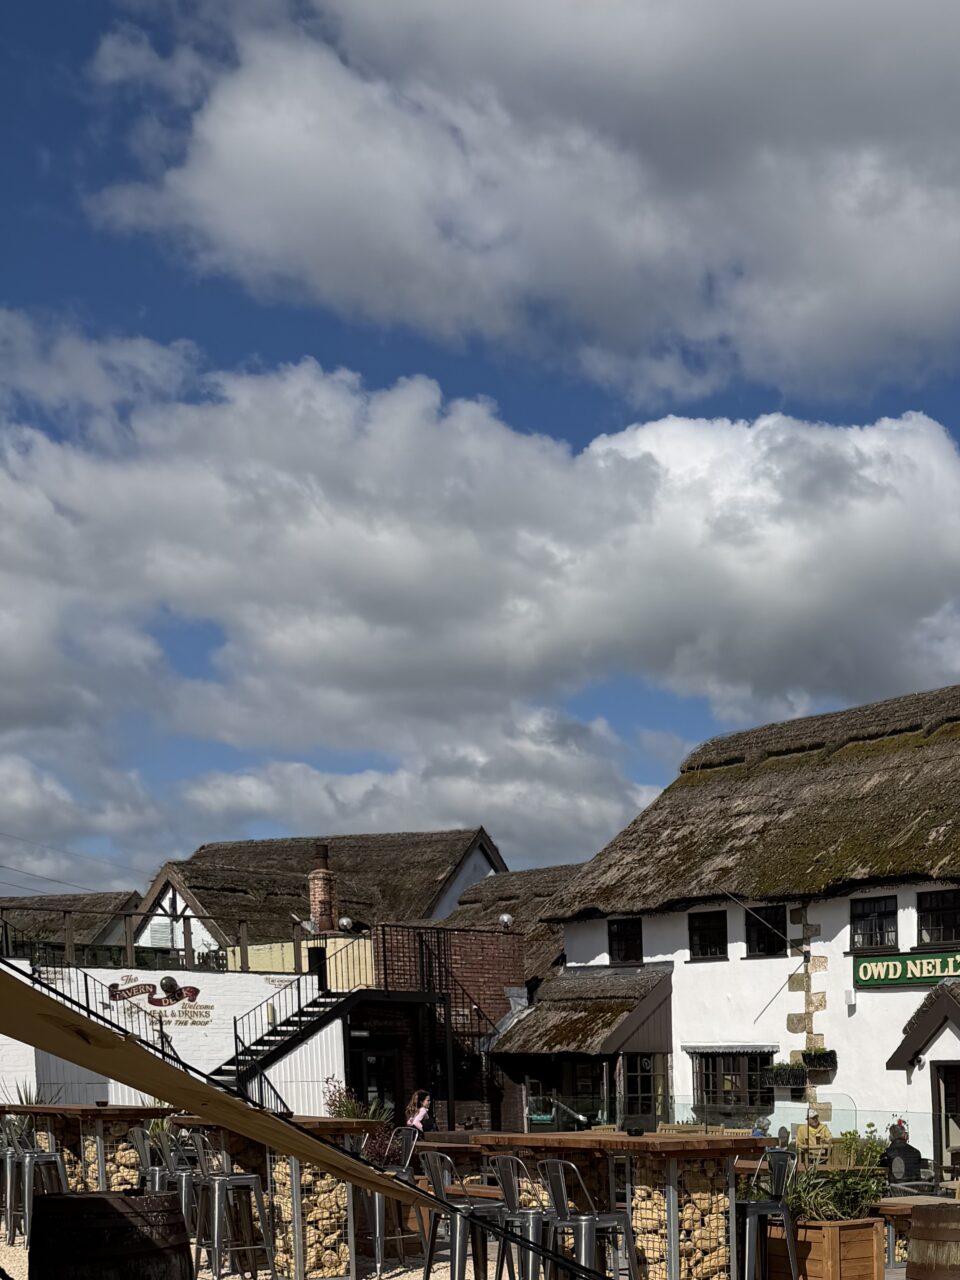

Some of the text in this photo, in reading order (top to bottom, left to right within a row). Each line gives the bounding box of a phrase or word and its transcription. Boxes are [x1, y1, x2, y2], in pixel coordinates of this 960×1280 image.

[859, 961, 902, 981] OWD
[121, 974, 139, 986] The
[115, 985, 154, 1000] TAVERN
[181, 1001, 215, 1010] Welcome
[177, 1009, 211, 1020] DRINKS
